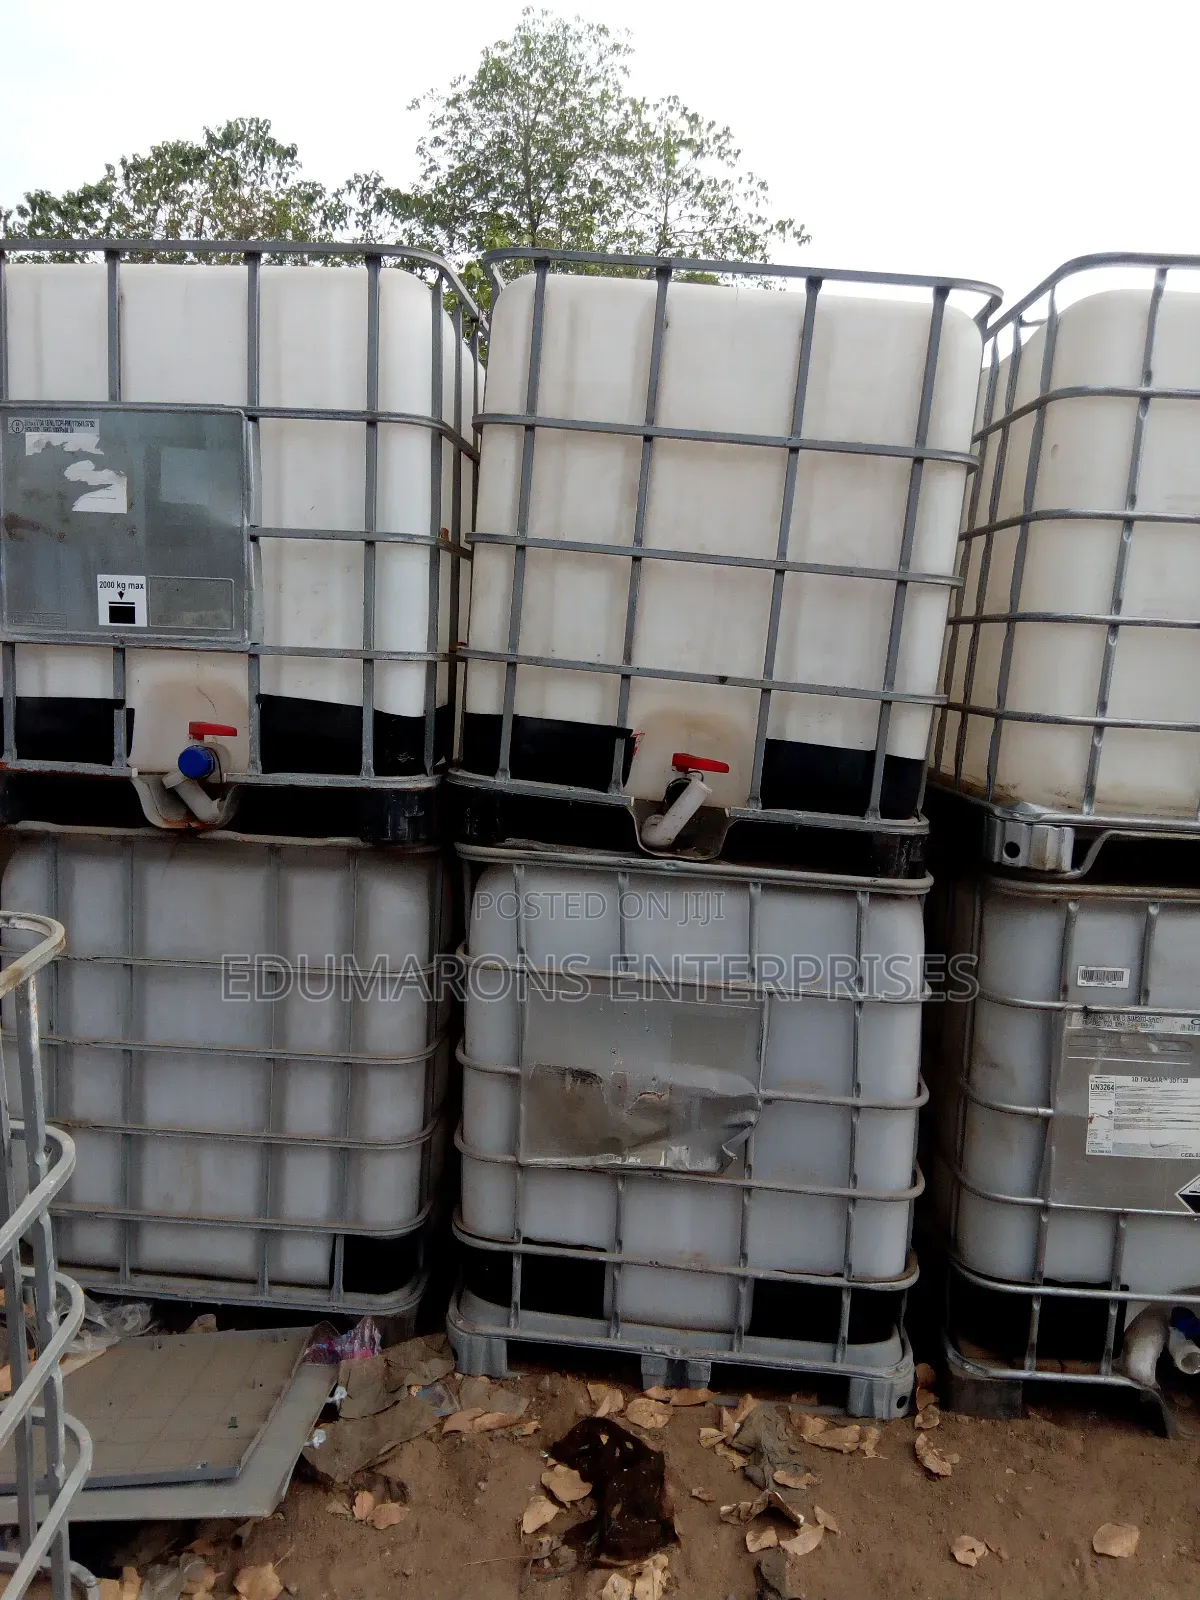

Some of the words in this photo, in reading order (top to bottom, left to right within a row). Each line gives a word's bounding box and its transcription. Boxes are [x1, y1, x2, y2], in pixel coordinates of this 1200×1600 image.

[99, 581, 114, 589] 2000
[116, 581, 126, 591] kg
[128, 582, 144, 590] max
[1090, 1083, 1115, 1091] UN3264
